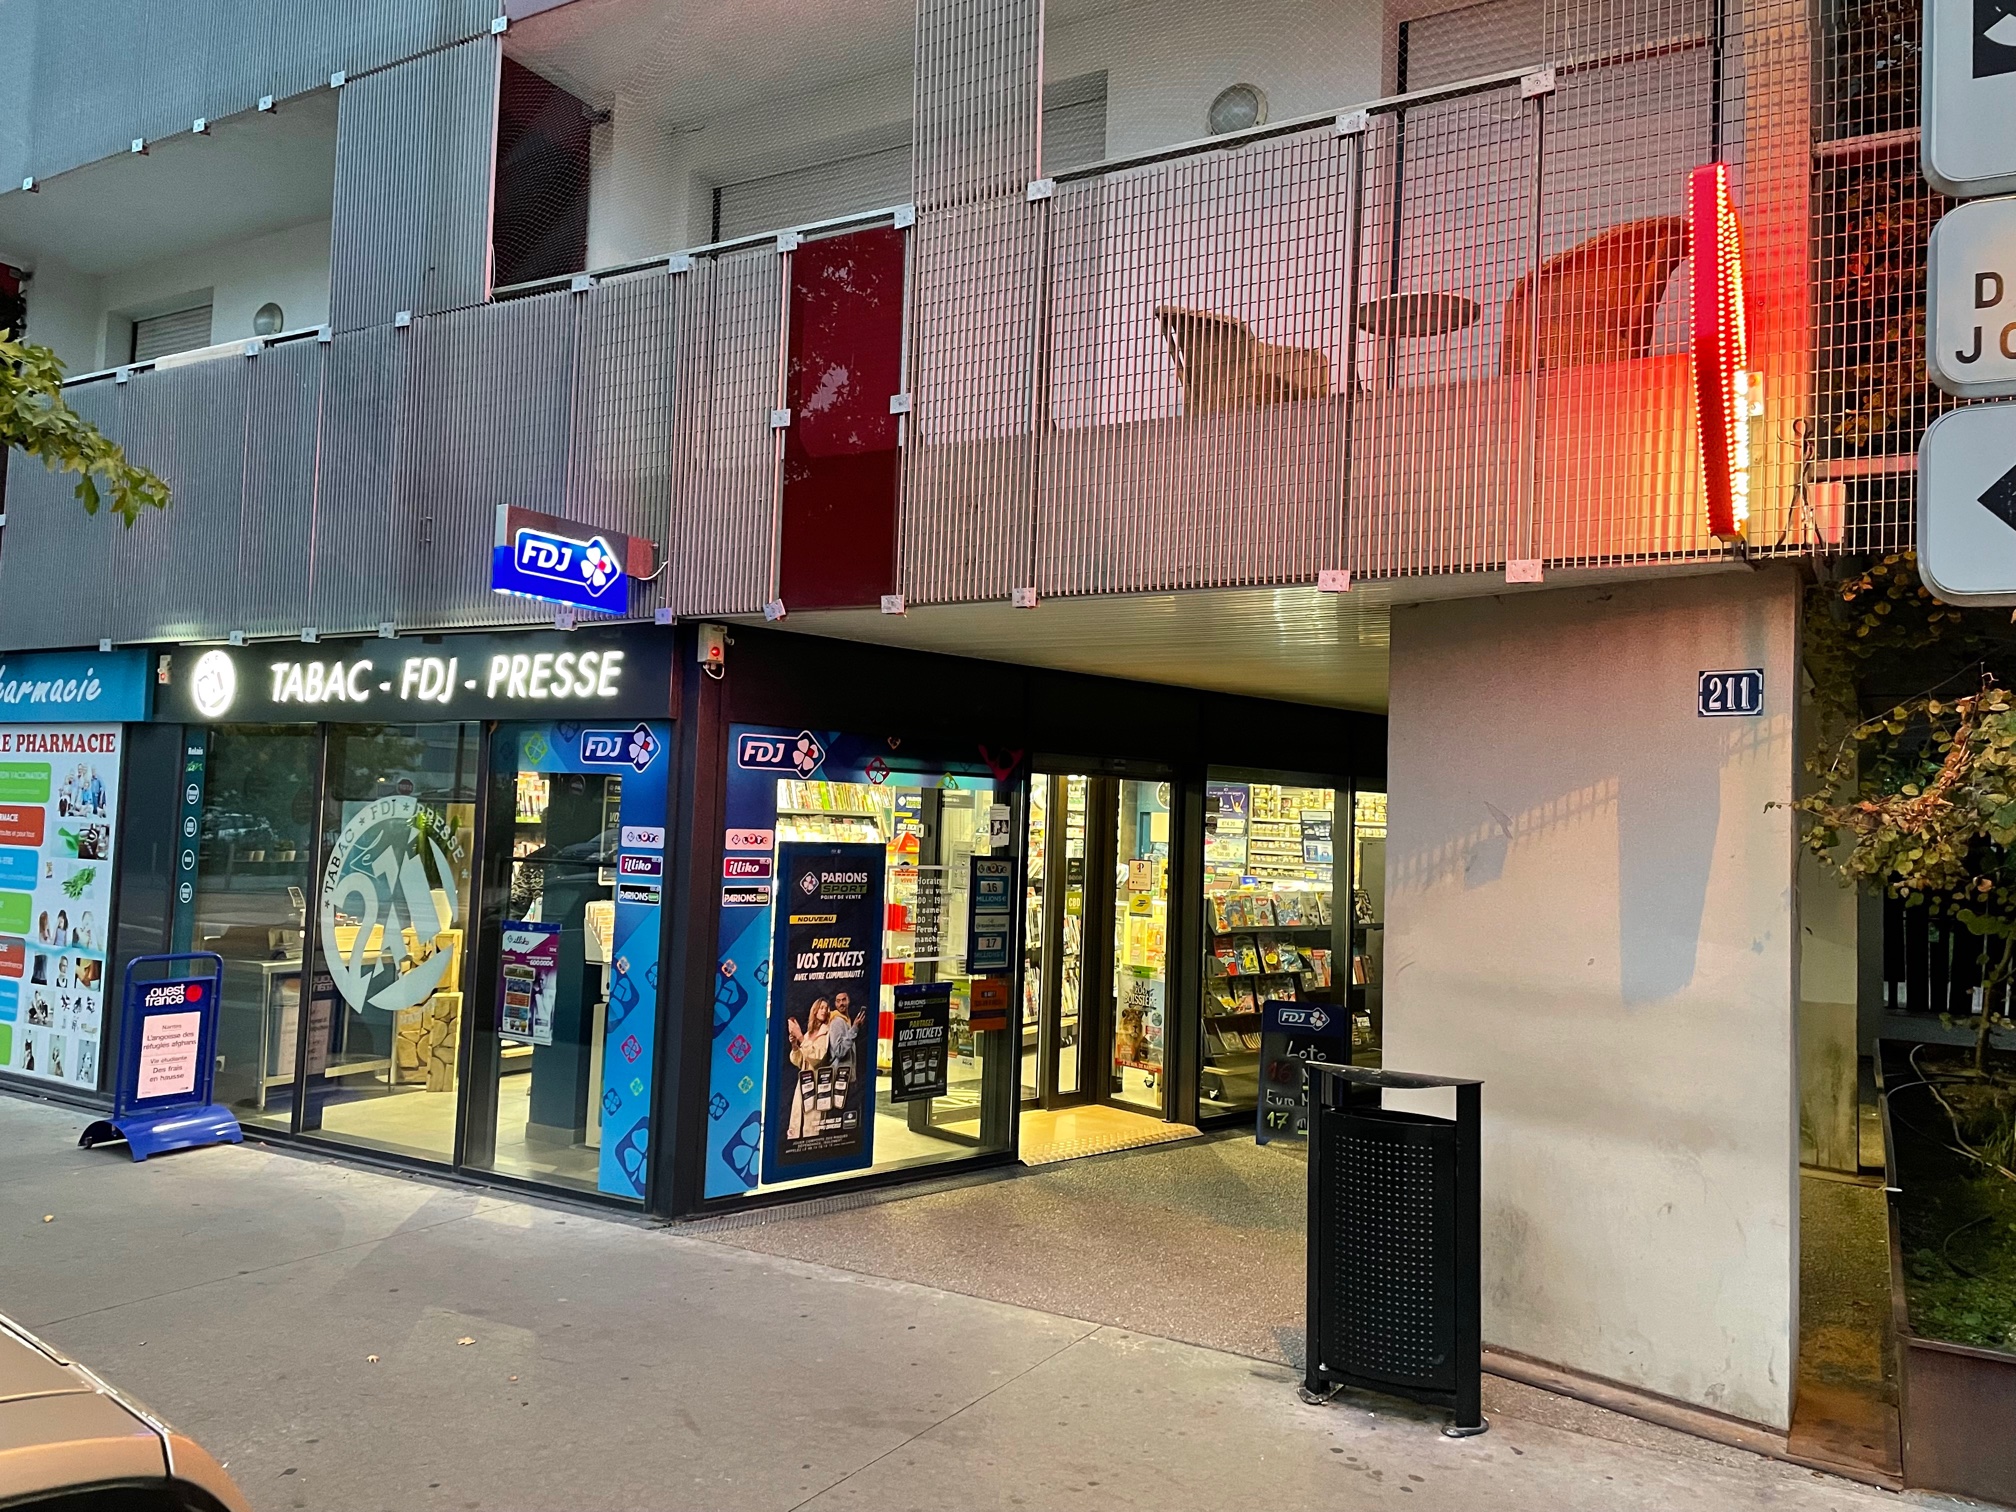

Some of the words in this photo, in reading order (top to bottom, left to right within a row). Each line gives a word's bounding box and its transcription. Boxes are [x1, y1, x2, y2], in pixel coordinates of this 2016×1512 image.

[521, 539, 573, 572] FDJ
[270, 659, 374, 702] TABAC
[400, 656, 458, 704] FDJ
[486, 650, 625, 699] PRESSE
[1709, 677, 1751, 710] 211
[16, 733, 116, 753] PHARMACIE
[585, 736, 623, 757] FDJ
[743, 741, 786, 763] FDJ
[370, 799, 397, 821] FDJ
[414, 804, 466, 864] PRESSE
[324, 828, 355, 894] TABAC
[624, 858, 652, 872] illiko
[728, 861, 760, 875] illiko
[821, 872, 868, 883] PARIONS
[822, 884, 866, 893] SPORT
[986, 882, 998, 893] 16
[620, 890, 649, 902] PARIONS
[724, 893, 757, 903] PARIONS
[1068, 897, 1081, 907] CBD
[812, 937, 851, 949] PARTAGEZ
[986, 938, 997, 948] 17
[796, 952, 820, 969] VOS
[822, 950, 865, 968] TICKETS
[150, 983, 185, 997] ouest
[144, 994, 184, 1007] france
[1281, 1012, 1306, 1023] FDJ
[899, 1029, 915, 1041] VOS
[915, 1026, 944, 1039] TICKETS
[171, 1039, 197, 1048] afghans
[1286, 1040, 1327, 1061] Loto
[152, 1066, 166, 1074] Des
[159, 1073, 185, 1081] hausse
[1266, 1088, 1295, 1106] Euro
[1266, 1111, 1290, 1130] 17
